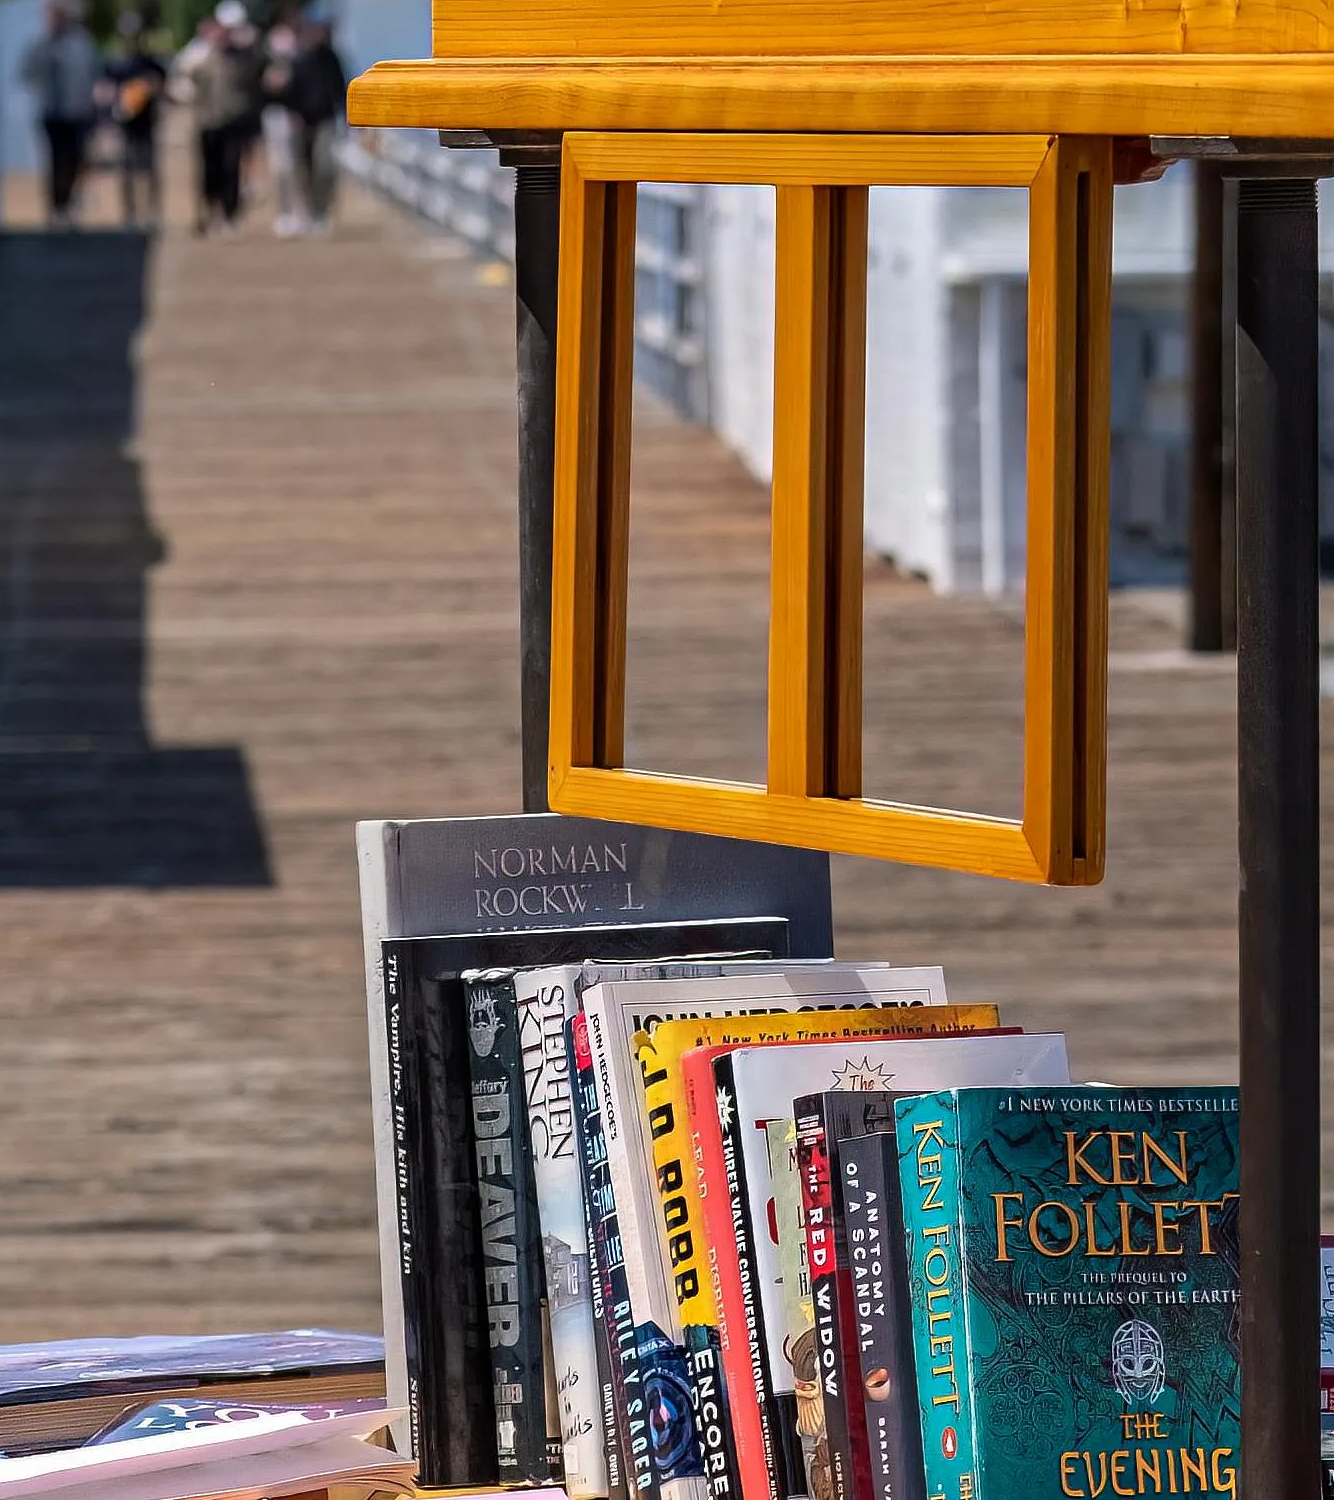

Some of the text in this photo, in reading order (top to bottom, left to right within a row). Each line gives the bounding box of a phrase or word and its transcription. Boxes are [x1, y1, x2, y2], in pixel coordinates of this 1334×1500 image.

[473, 843, 627, 879] NORMAN
[475, 882, 644, 918] ROCKWL
[589, 1012, 603, 1050] JOHN
[517, 994, 549, 1163] KING
[540, 985, 574, 1159] STEPHEN
[848, 1072, 875, 1090] The
[1020, 1098, 1056, 1113] NEW
[1060, 1098, 1105, 1113] YORK
[1107, 1098, 1154, 1113] TIMES
[1159, 1098, 1240, 1113] BESTSELLE
[722, 1133, 739, 1194] THREE
[806, 1165, 817, 1194] THE
[1062, 1130, 1189, 1186] KEN
[472, 1094, 520, 1349] DEAVER
[657, 1157, 700, 1306] ROBB
[730, 1198, 747, 1254] VALUE
[809, 1206, 827, 1268] RED
[846, 1162, 875, 1353] OF A SCANDAL
[864, 1190, 885, 1317] ANATOMY
[913, 1119, 960, 1415] KEN FOLLETT
[1080, 1272, 1187, 1286] THE PREQUEL TO
[1024, 1292, 1058, 1306] THE
[1063, 1291, 1123, 1306] PILLARS
[1126, 1291, 1150, 1305] OF
[1153, 1291, 1187, 1305] THE
[737, 1256, 766, 1404] CONVERSATIONS
[816, 1282, 839, 1398] WIDOW
[614, 1299, 652, 1490] RILEY SAGER
[694, 1348, 730, 1496] ENCORE
[877, 1416, 890, 1476] SARAH
[1119, 1411, 1169, 1440] THE
